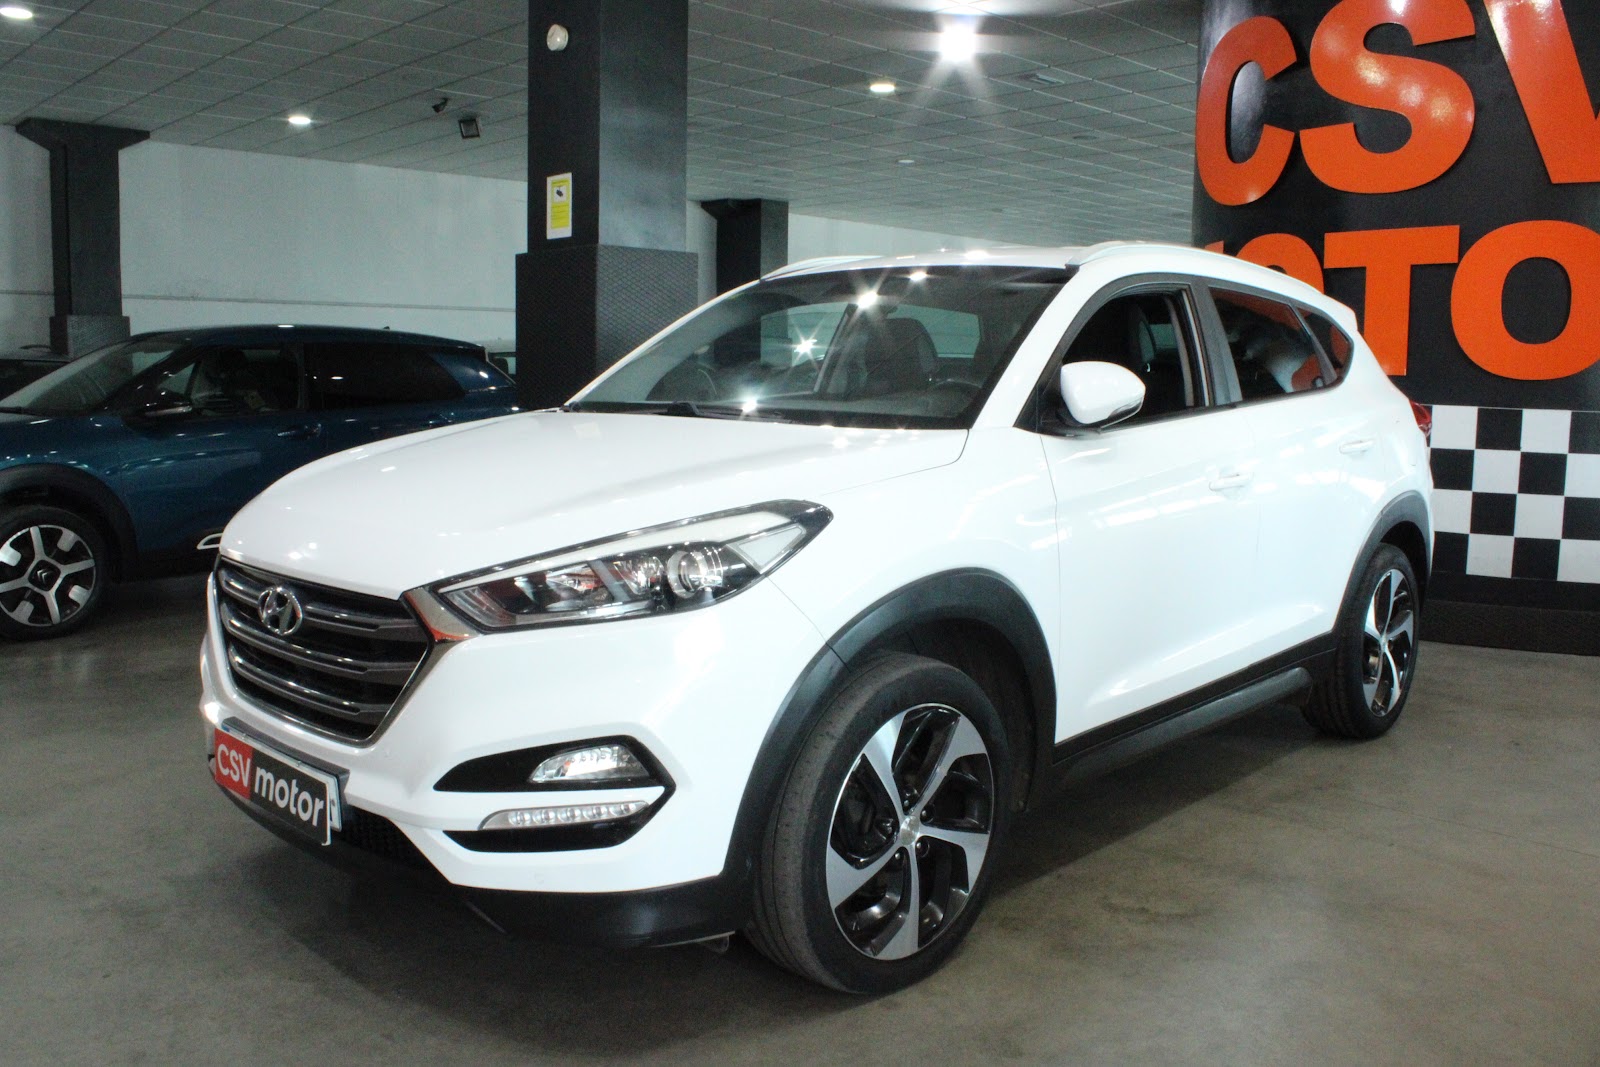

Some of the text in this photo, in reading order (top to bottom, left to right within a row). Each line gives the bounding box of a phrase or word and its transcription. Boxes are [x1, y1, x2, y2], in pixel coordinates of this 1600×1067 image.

[1205, 220, 1600, 380] TO
[217, 743, 250, 787] CSV
[254, 766, 324, 827] motor
